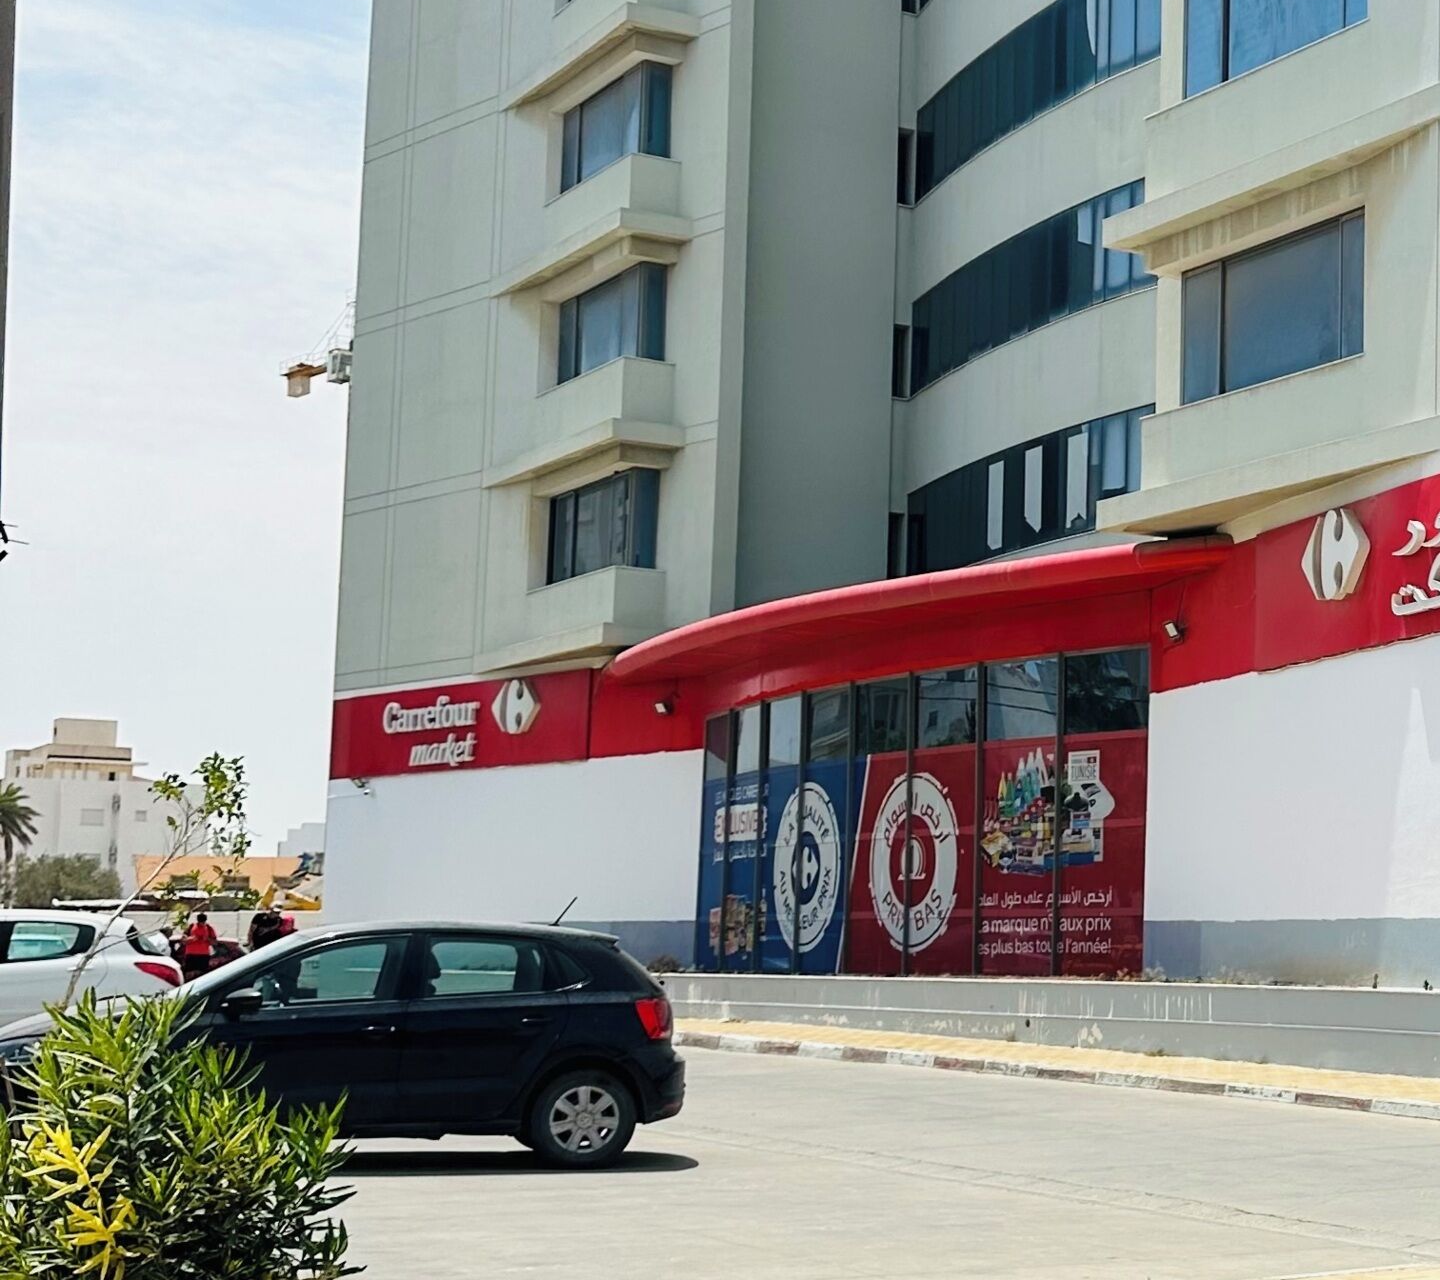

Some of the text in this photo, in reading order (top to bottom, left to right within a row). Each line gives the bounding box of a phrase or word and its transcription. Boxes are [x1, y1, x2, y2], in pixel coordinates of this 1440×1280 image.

[383, 695, 480, 734] Carrefour
[408, 732, 477, 767] market
[914, 888, 942, 931] BAS
[991, 917, 1038, 936] marque
[1060, 917, 1082, 931] aux
[1085, 913, 1111, 936] prix
[991, 939, 1013, 958] plus
[1014, 938, 1034, 954] bas
